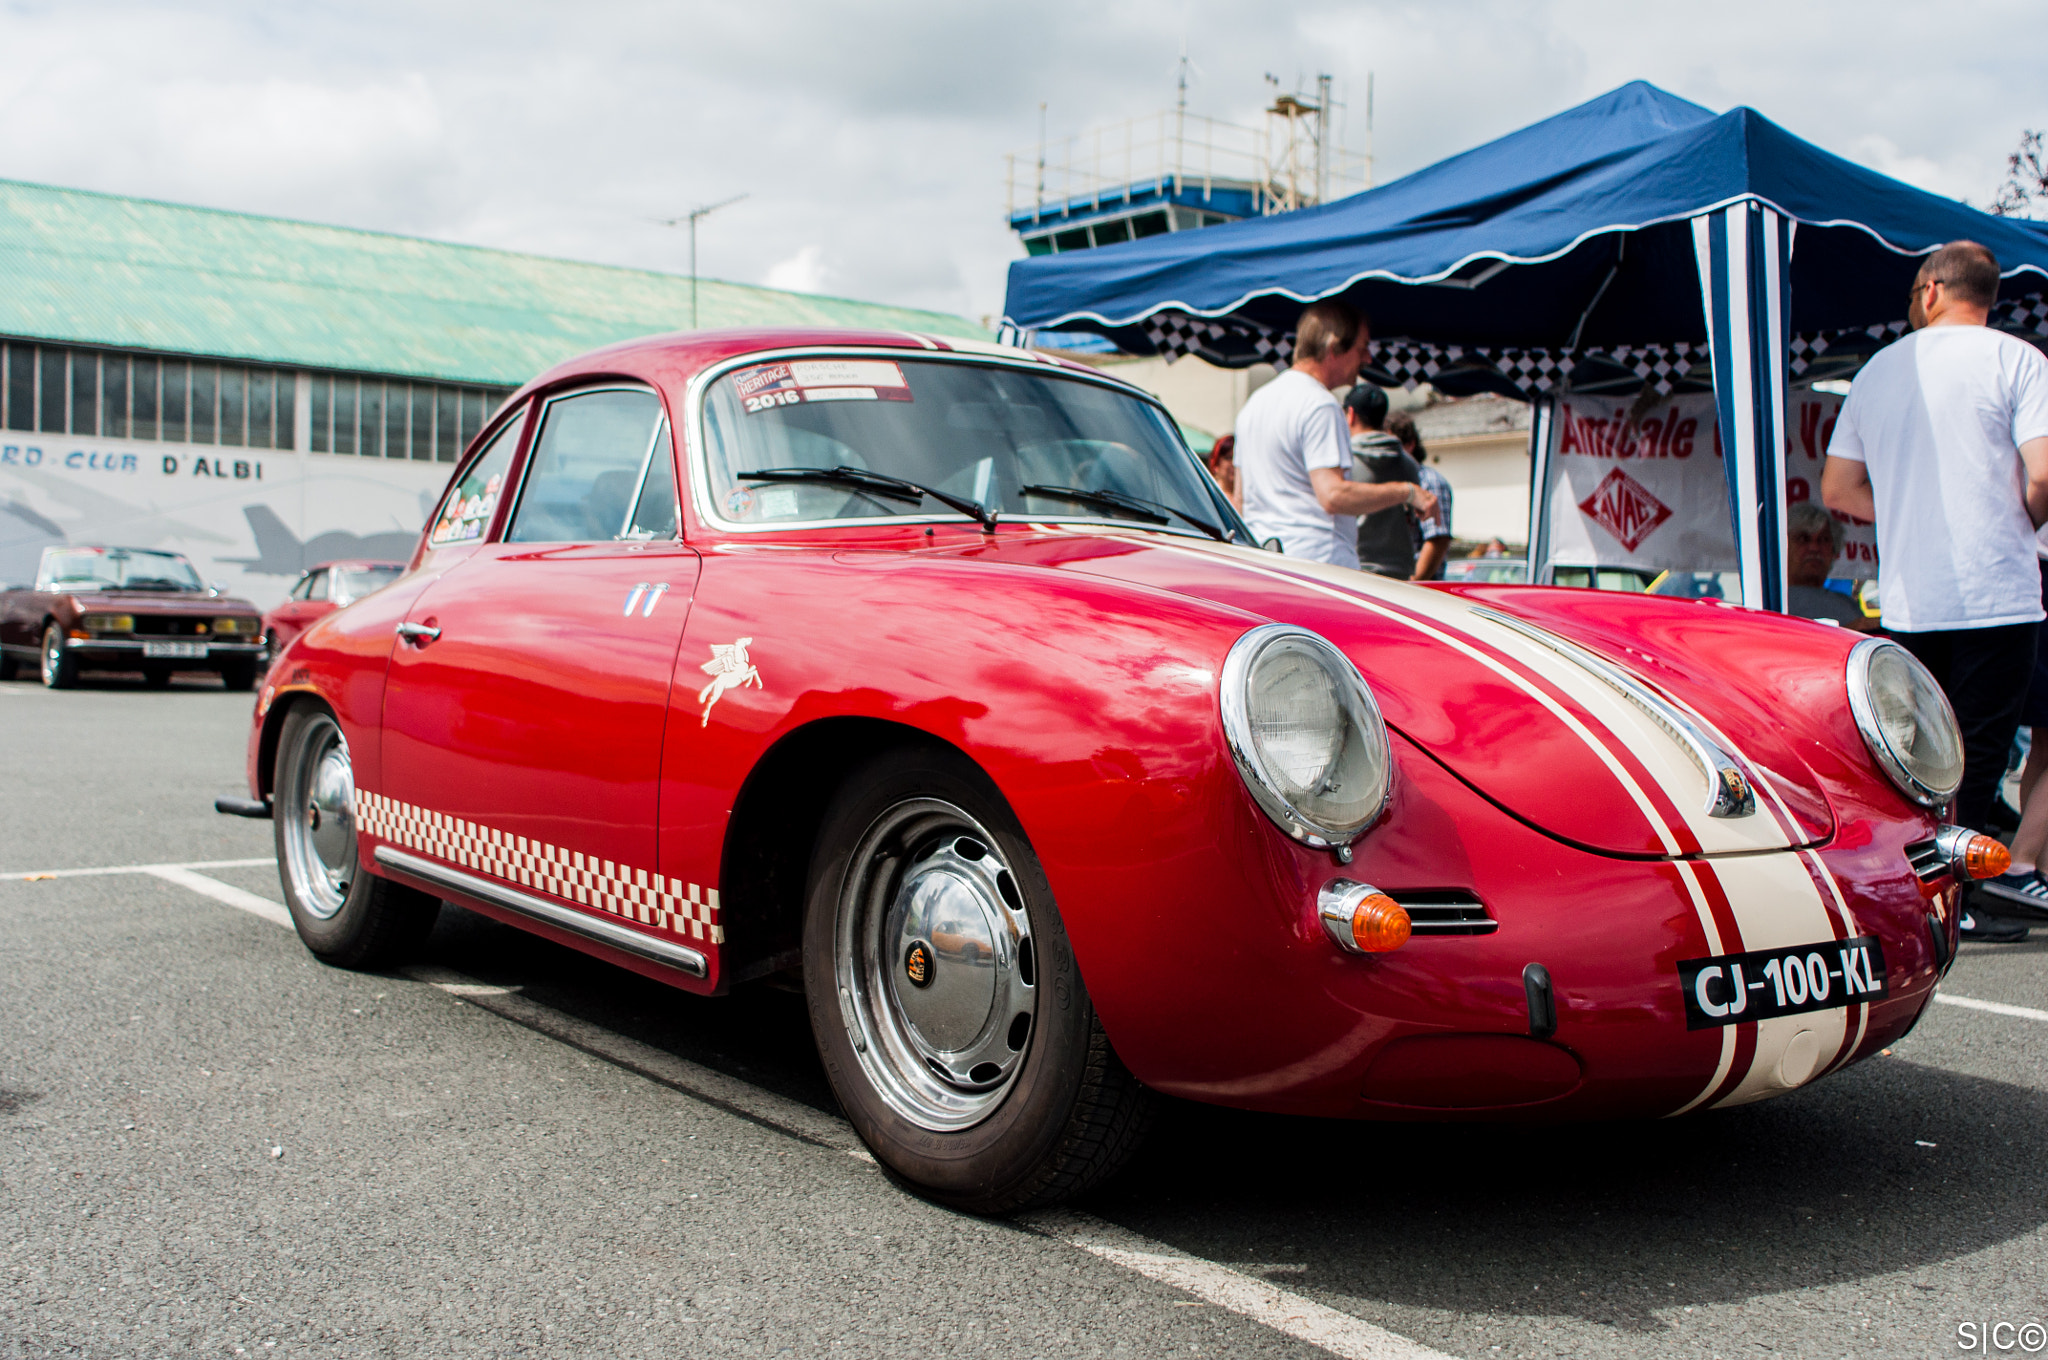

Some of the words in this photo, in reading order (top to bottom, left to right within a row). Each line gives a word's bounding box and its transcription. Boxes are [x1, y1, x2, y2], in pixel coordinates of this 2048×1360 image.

[741, 365, 789, 396] HERITAGE
[796, 362, 848, 372] PORSCHE
[745, 389, 800, 412] 2016
[1559, 402, 1699, 459] Amicale
[1695, 946, 1882, 1018] CJ-100-KL
